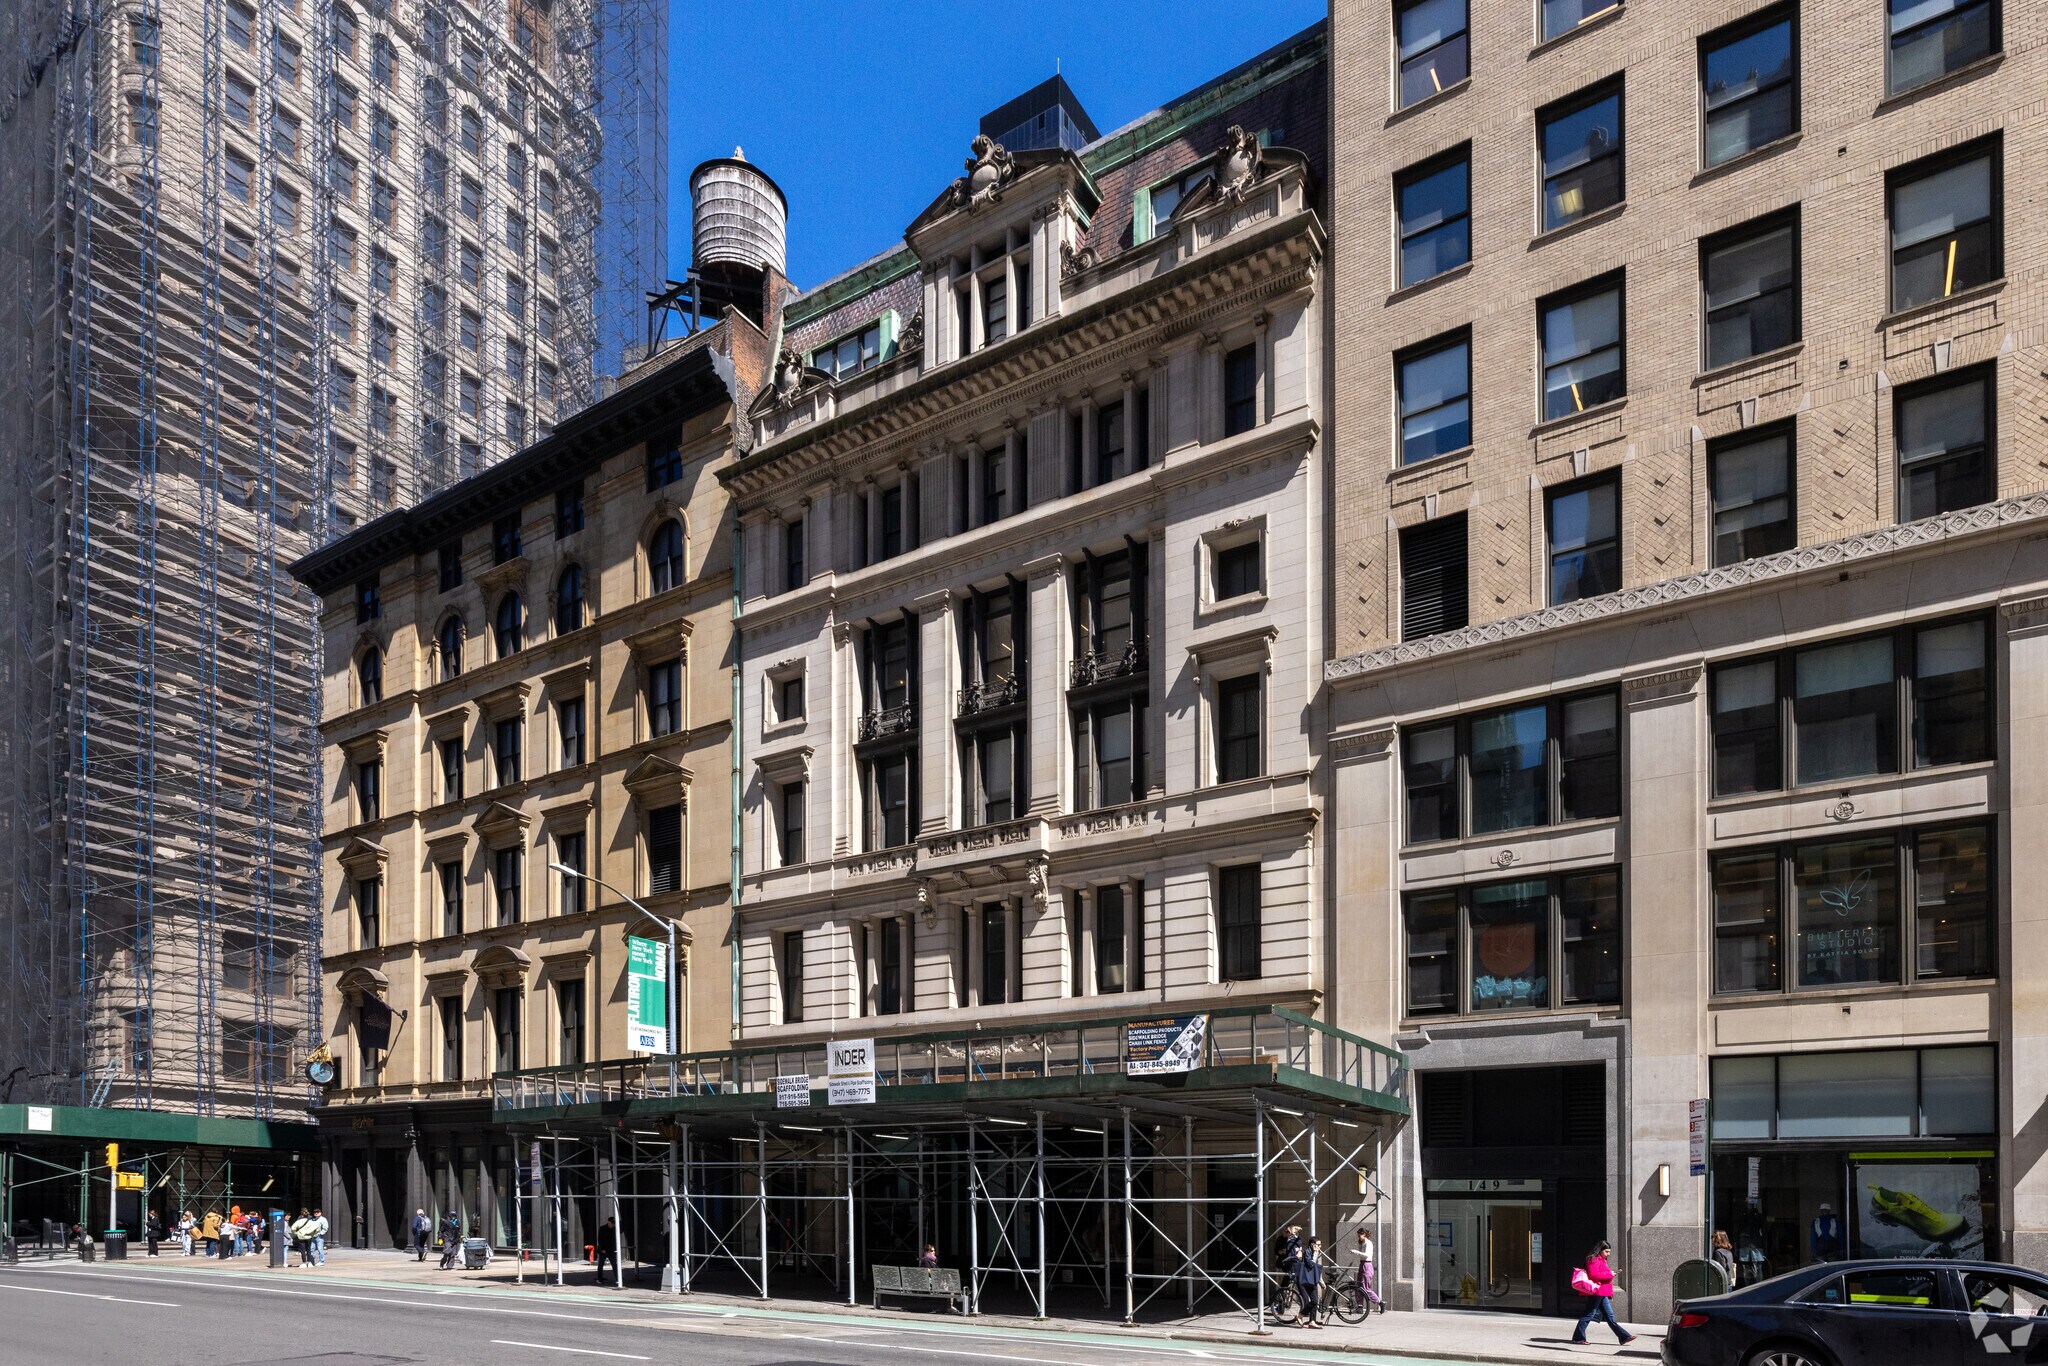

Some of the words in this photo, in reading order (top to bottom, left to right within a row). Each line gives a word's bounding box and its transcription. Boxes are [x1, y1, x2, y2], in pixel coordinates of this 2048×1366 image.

[1807, 928, 1884, 941] BUTTERFLY
[632, 939, 648, 948] Where
[1819, 937, 1873, 949] STUDIO
[655, 942, 666, 981] NOMAD
[628, 972, 640, 1022] FLATIRON
[1128, 1020, 1175, 1028] MANUFACTURER
[640, 1035, 655, 1047] ABS
[834, 1048, 866, 1067] INDER
[1139, 1060, 1181, 1068] 347-845-8949
[777, 1084, 809, 1092] SCAFFOLDING
[832, 1089, 845, 1097] (347)
[1468, 1180, 1500, 1191] 149
